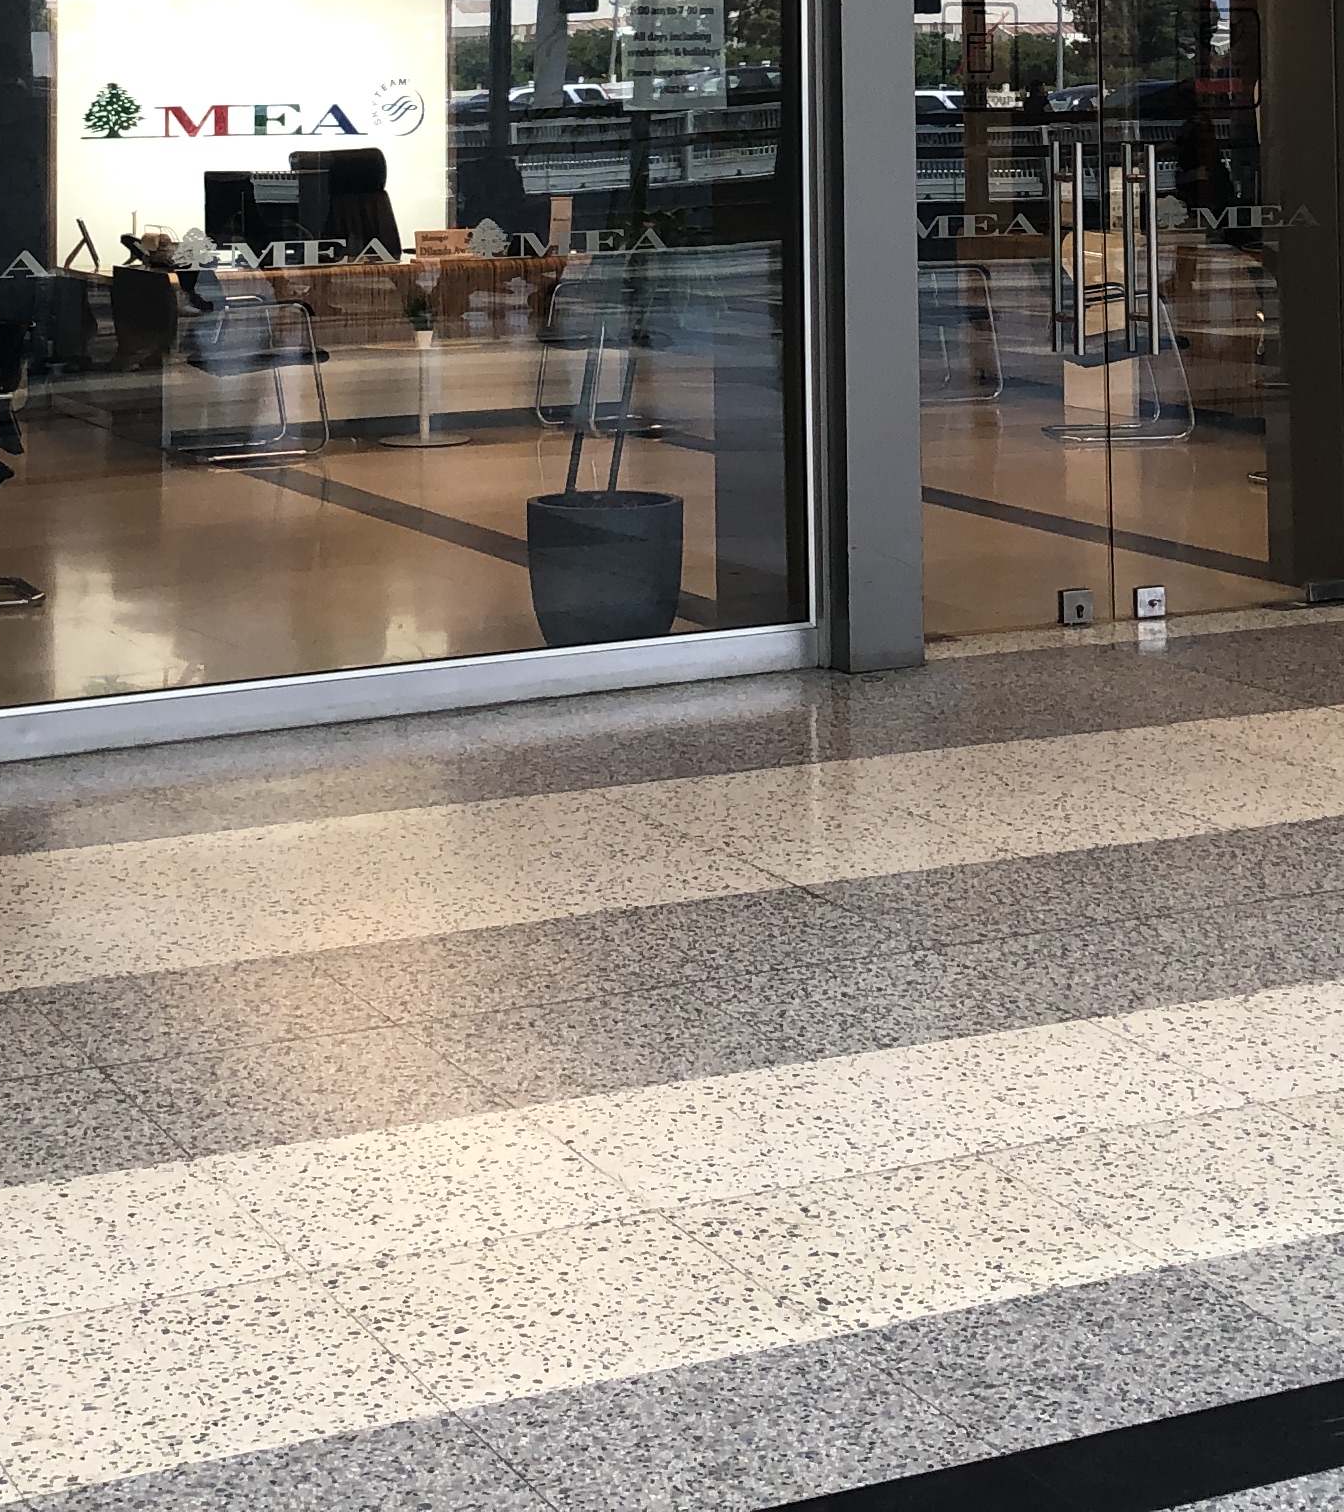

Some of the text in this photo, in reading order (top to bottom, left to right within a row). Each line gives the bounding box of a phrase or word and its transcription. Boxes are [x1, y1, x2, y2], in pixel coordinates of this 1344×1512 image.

[372, 79, 407, 125] SKYTEAM
[154, 103, 368, 137] MEA
[1191, 203, 1320, 231] MEA
[225, 237, 404, 271] MEA
[512, 228, 673, 258] MEA
